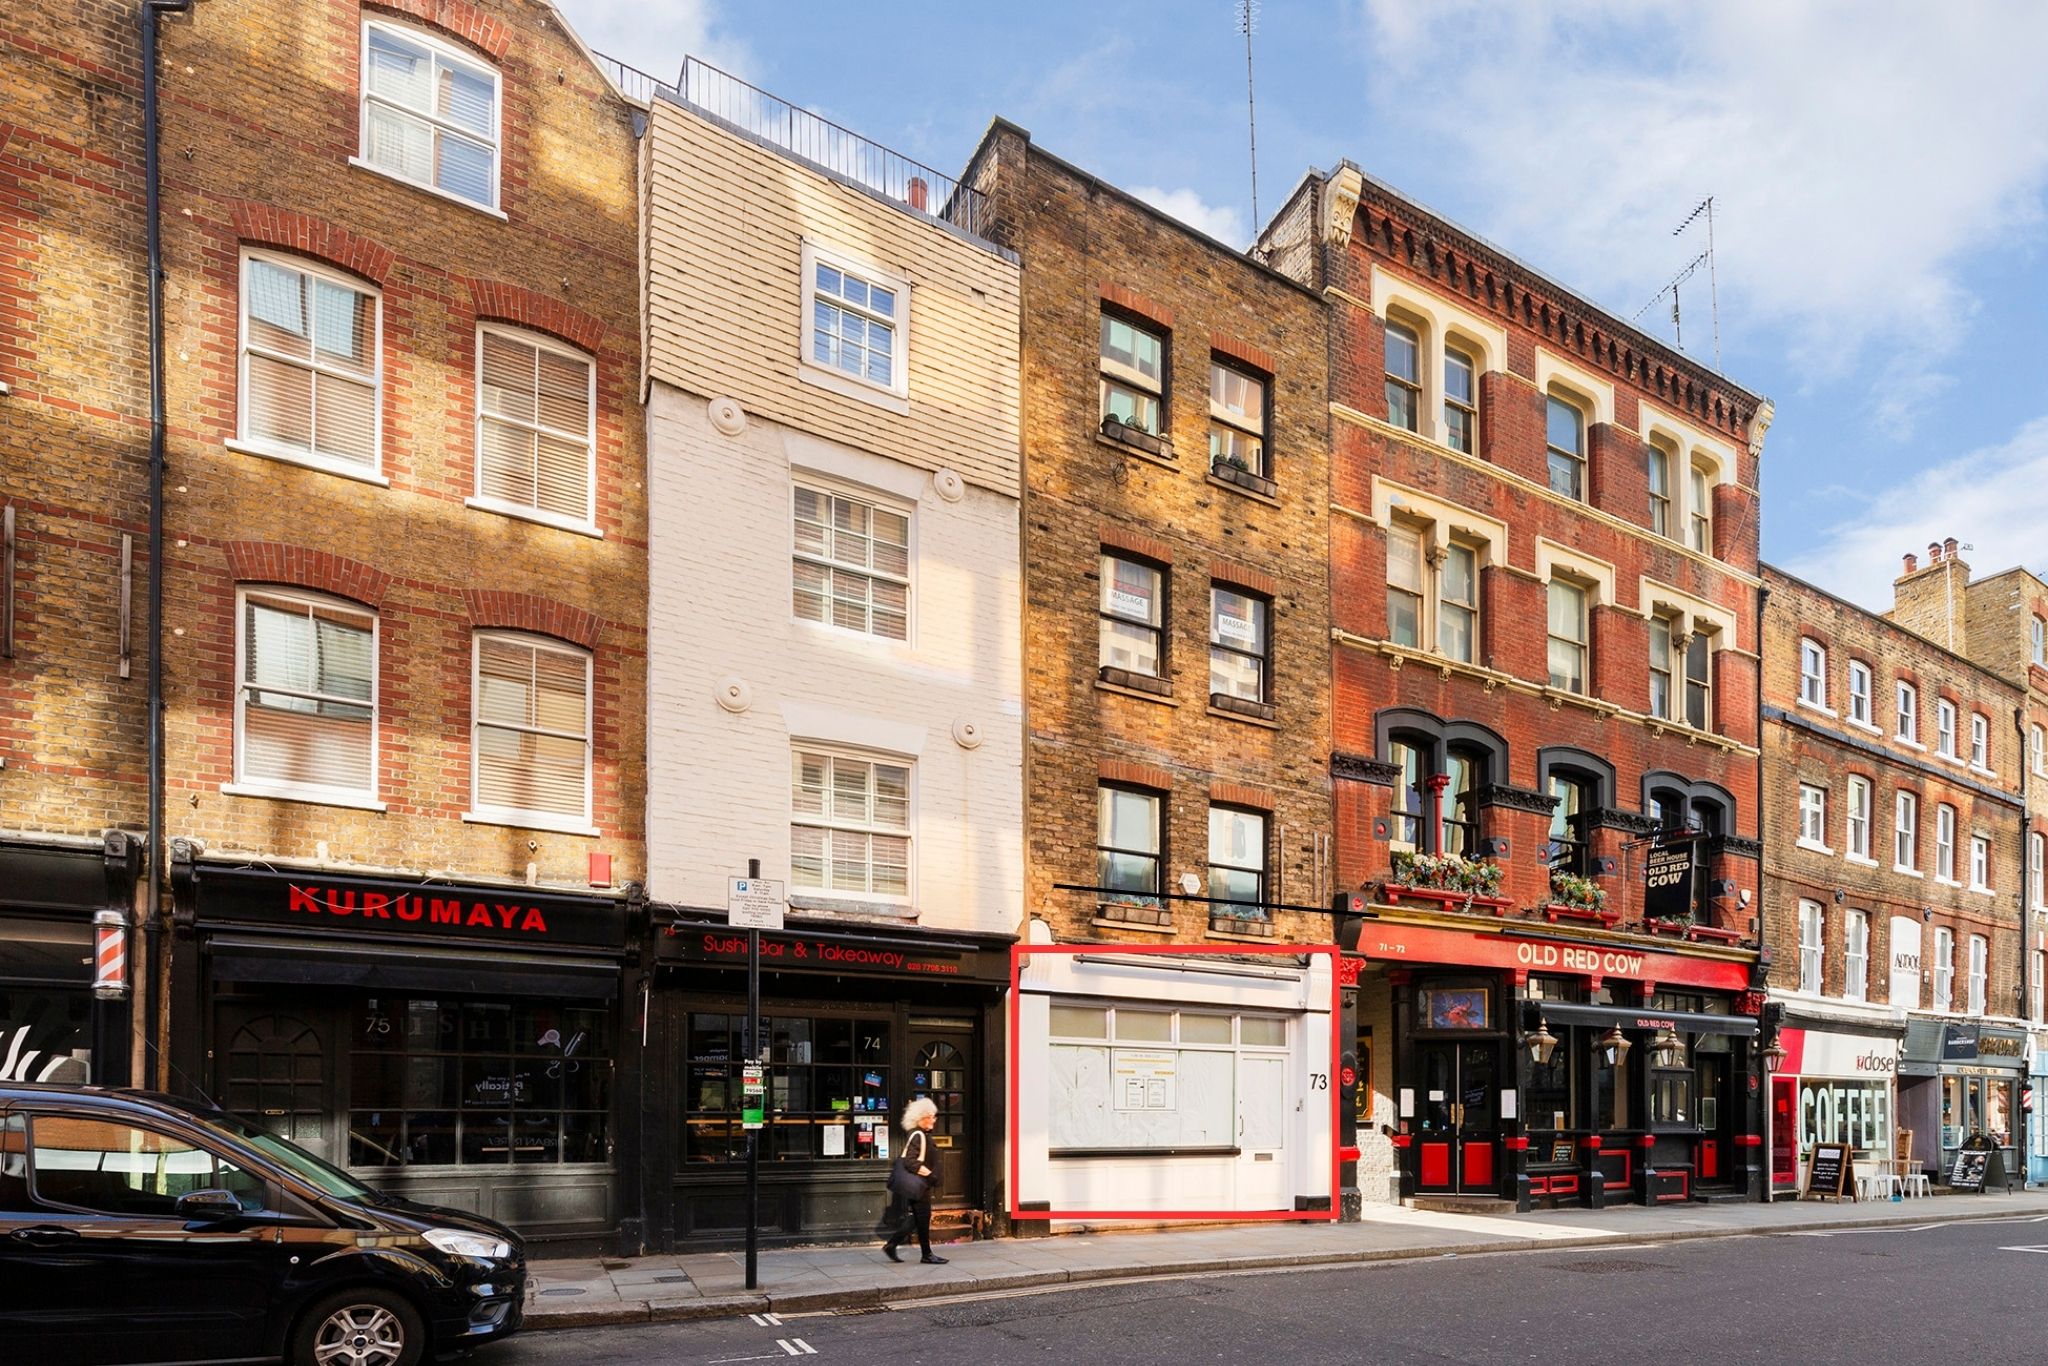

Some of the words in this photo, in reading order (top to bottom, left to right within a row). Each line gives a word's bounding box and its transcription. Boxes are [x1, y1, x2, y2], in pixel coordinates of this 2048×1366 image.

[1111, 591, 1144, 607] MASSAGE
[1222, 617, 1251, 633] MASSAG
[1649, 850, 1669, 859] LOCAL
[1666, 852, 1688, 861] HOUSE
[1648, 865, 1668, 876] OLD
[1669, 861, 1690, 872] RED
[1648, 872, 1682, 888] COW
[289, 886, 548, 932] KURUMAYA
[703, 935, 748, 954] Sushi
[758, 939, 784, 957] Bar
[793, 942, 808, 959] &
[816, 943, 904, 969] Takeaway
[1517, 942, 1558, 967] OLD
[1563, 948, 1600, 970] RED
[1603, 953, 1642, 975] COW
[366, 1017, 390, 1033] 75
[1637, 1019, 1650, 1027] OLD
[864, 1036, 880, 1050] 74
[1310, 1073, 1328, 1090] 73
[1800, 1087, 1887, 1151] COFFEE
